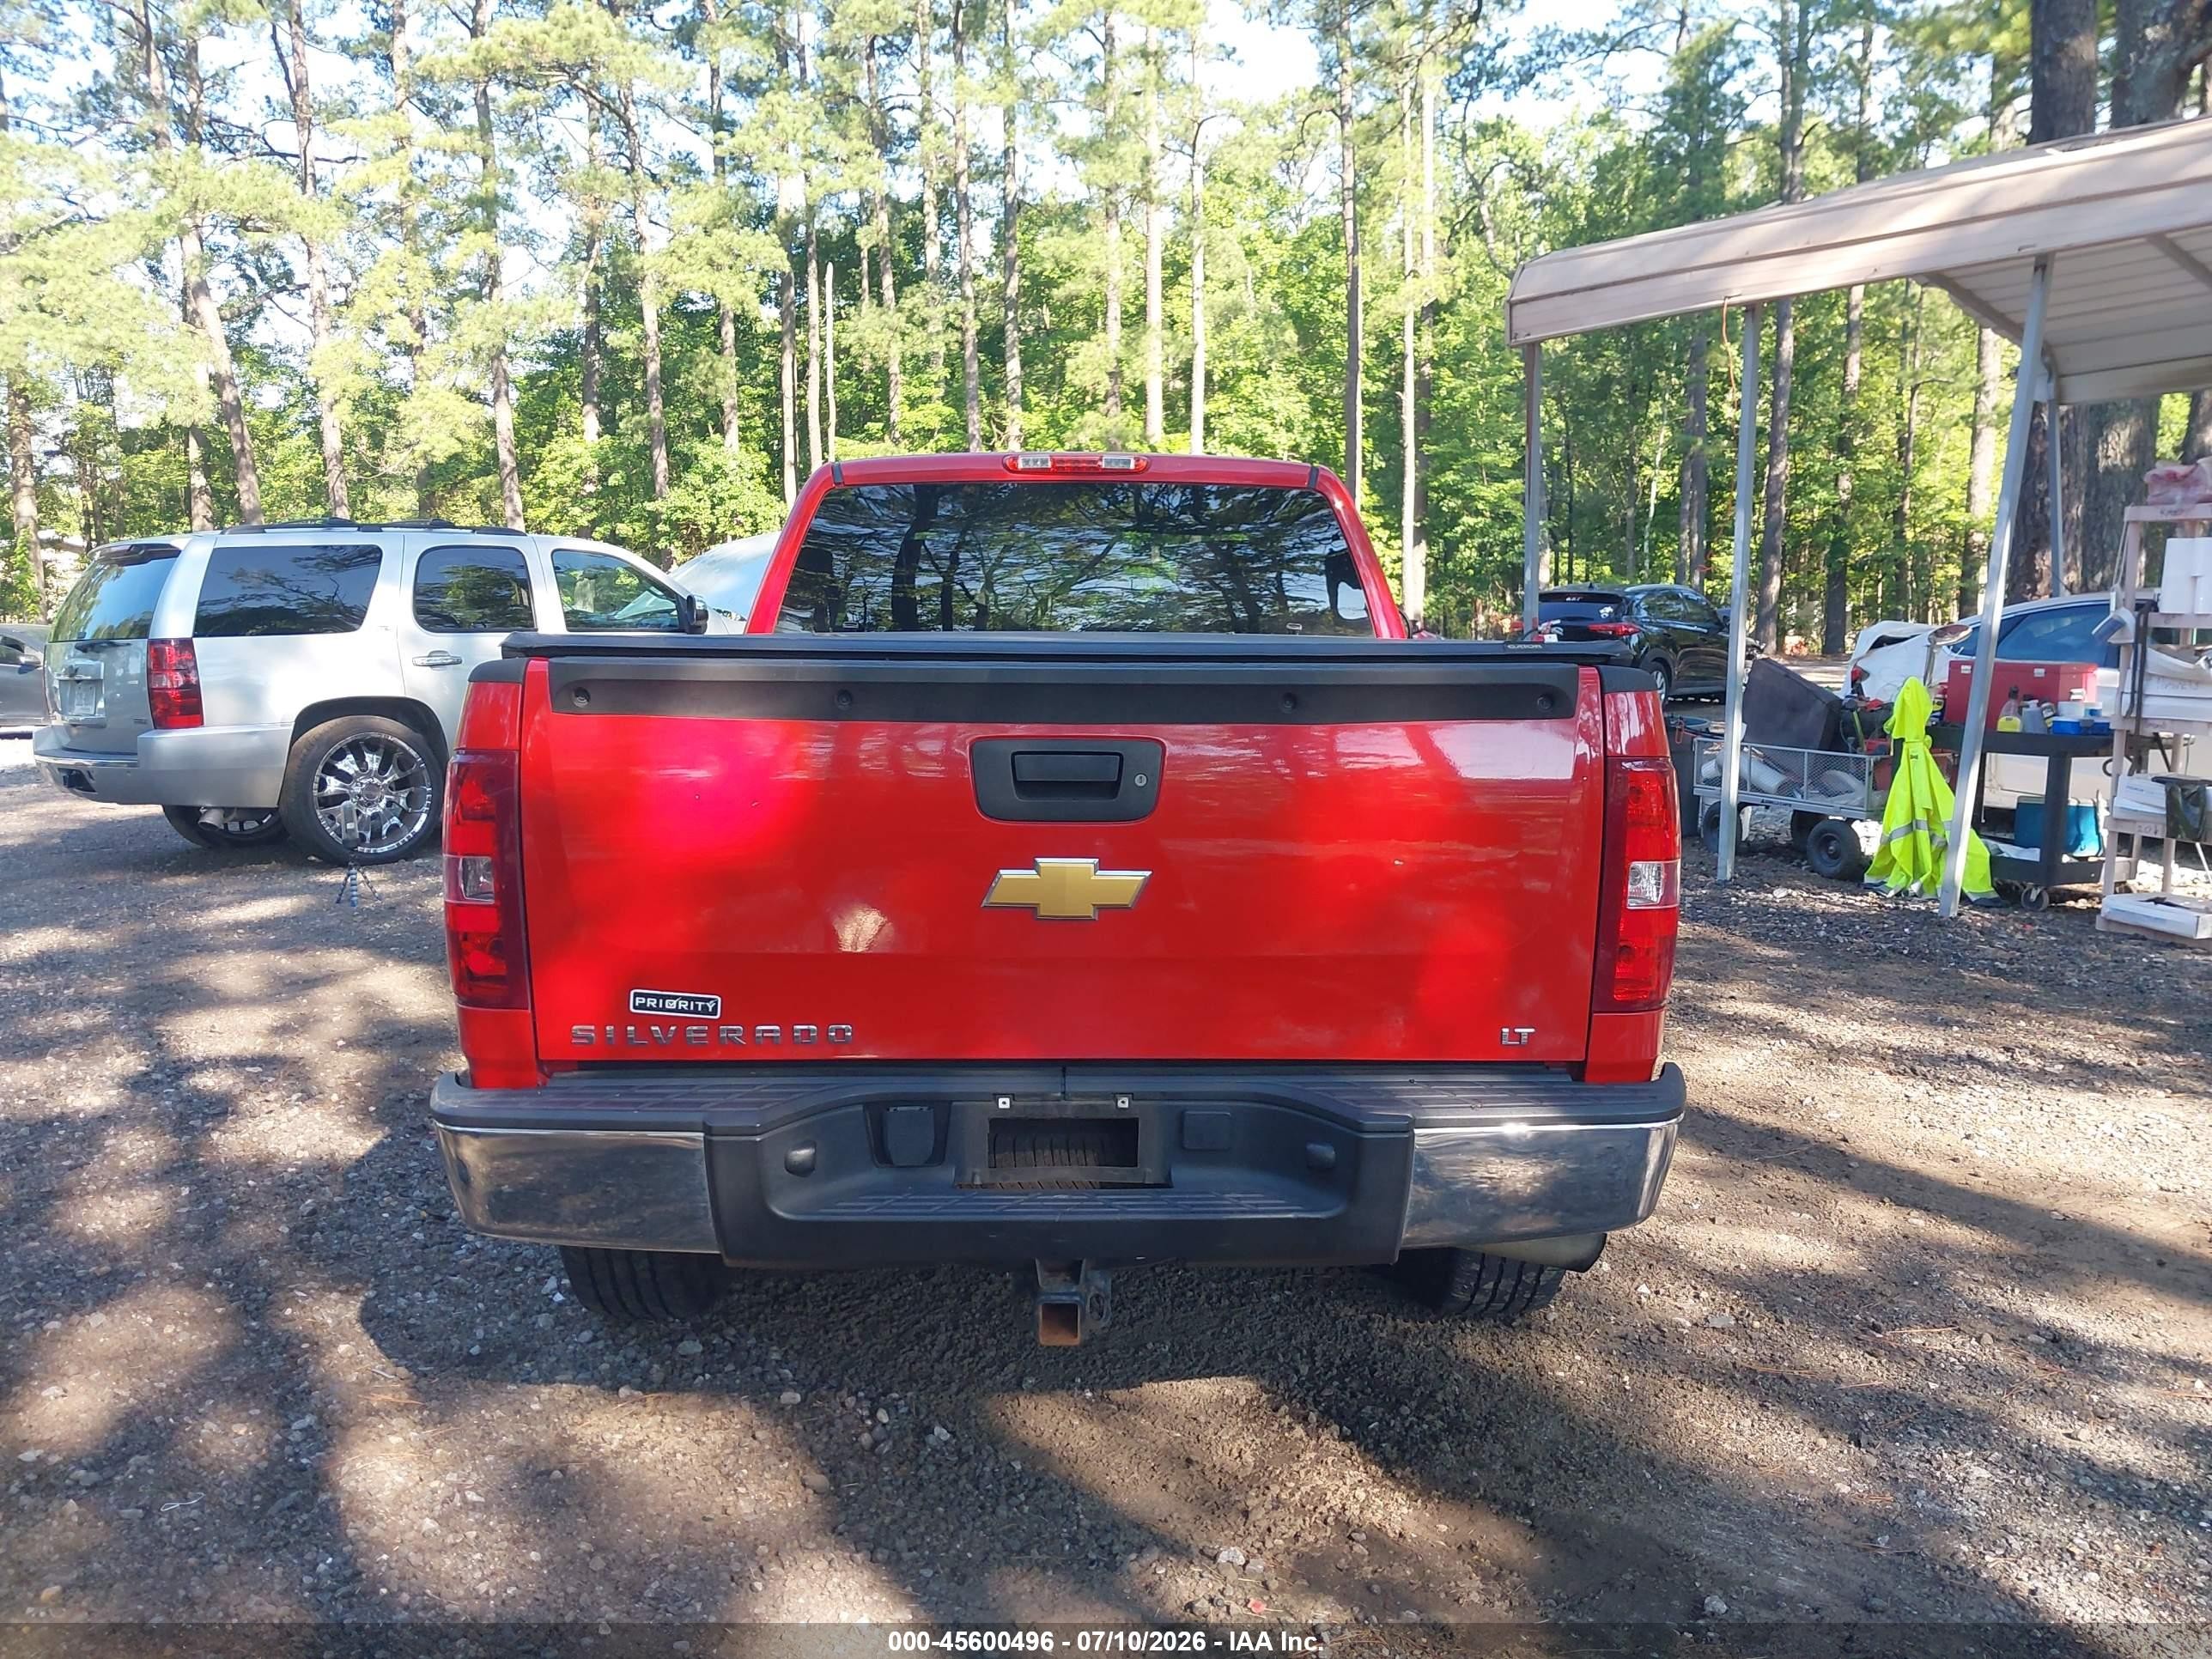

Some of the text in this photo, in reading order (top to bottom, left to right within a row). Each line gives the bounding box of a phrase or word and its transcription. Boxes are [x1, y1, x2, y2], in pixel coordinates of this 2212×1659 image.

[635, 996, 718, 1012] PRIORITY
[571, 1024, 853, 1045] SILVERADO
[1501, 1028, 1535, 1045] LT
